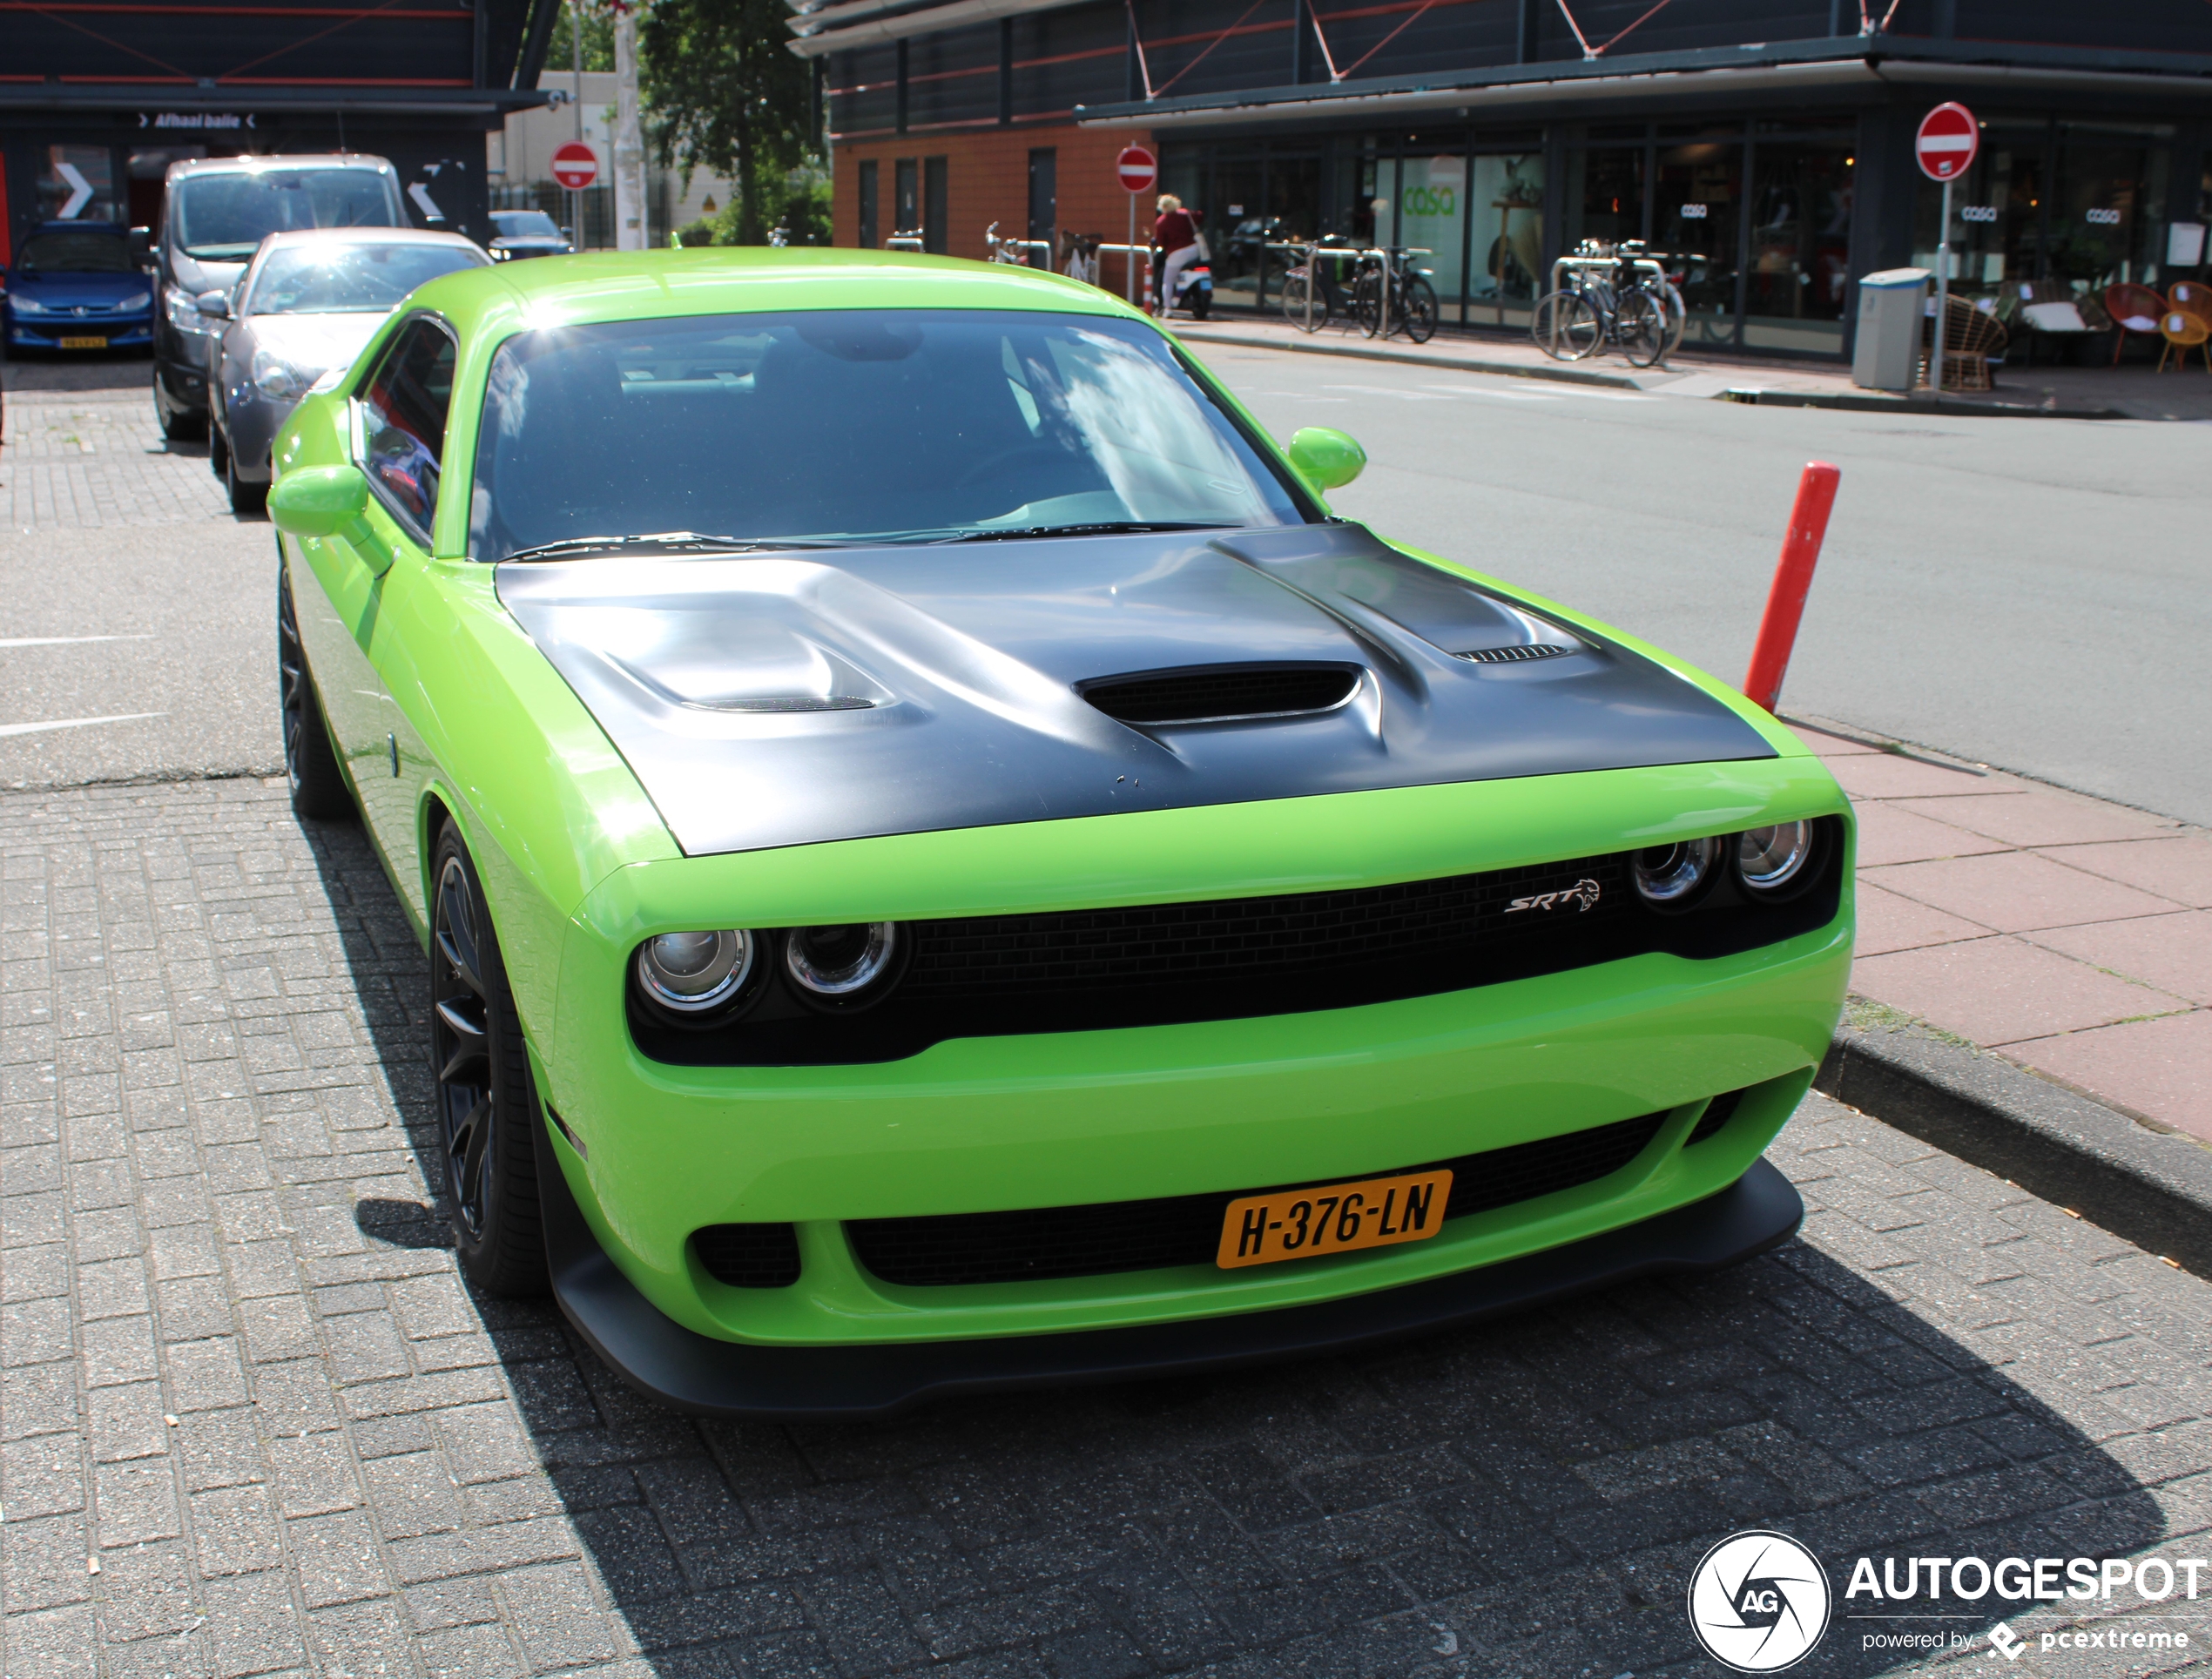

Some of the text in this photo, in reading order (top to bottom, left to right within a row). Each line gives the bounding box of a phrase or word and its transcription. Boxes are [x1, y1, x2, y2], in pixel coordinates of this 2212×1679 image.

[155, 112, 240, 128] Afhaal balie
[1504, 887, 1582, 913] SRT
[1238, 1181, 1434, 1258] H-376-LN
